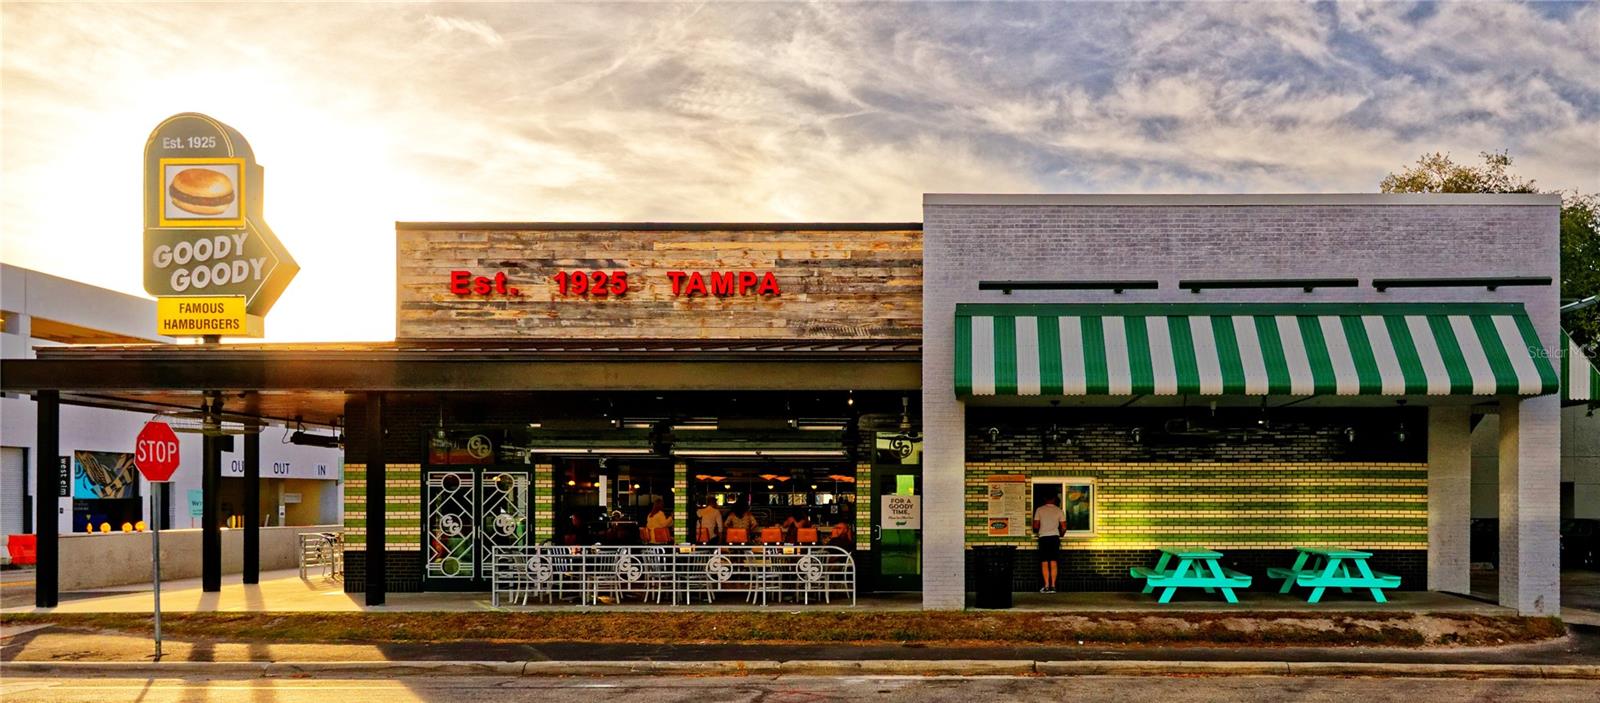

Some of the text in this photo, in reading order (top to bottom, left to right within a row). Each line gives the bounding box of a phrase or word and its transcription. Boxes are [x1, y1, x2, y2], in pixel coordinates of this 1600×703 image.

[162, 136, 216, 149] Est. 1925
[153, 232, 248, 268] GOODY
[170, 257, 267, 292] GOODY
[449, 270, 781, 297] Est. 1925 TAMPA
[179, 302, 225, 314] FAMOUS
[163, 318, 240, 330] HAMBURGERS
[137, 439, 178, 463] STOP
[231, 460, 245, 473] OU
[273, 462, 291, 475] OUT
[317, 464, 327, 476] IN
